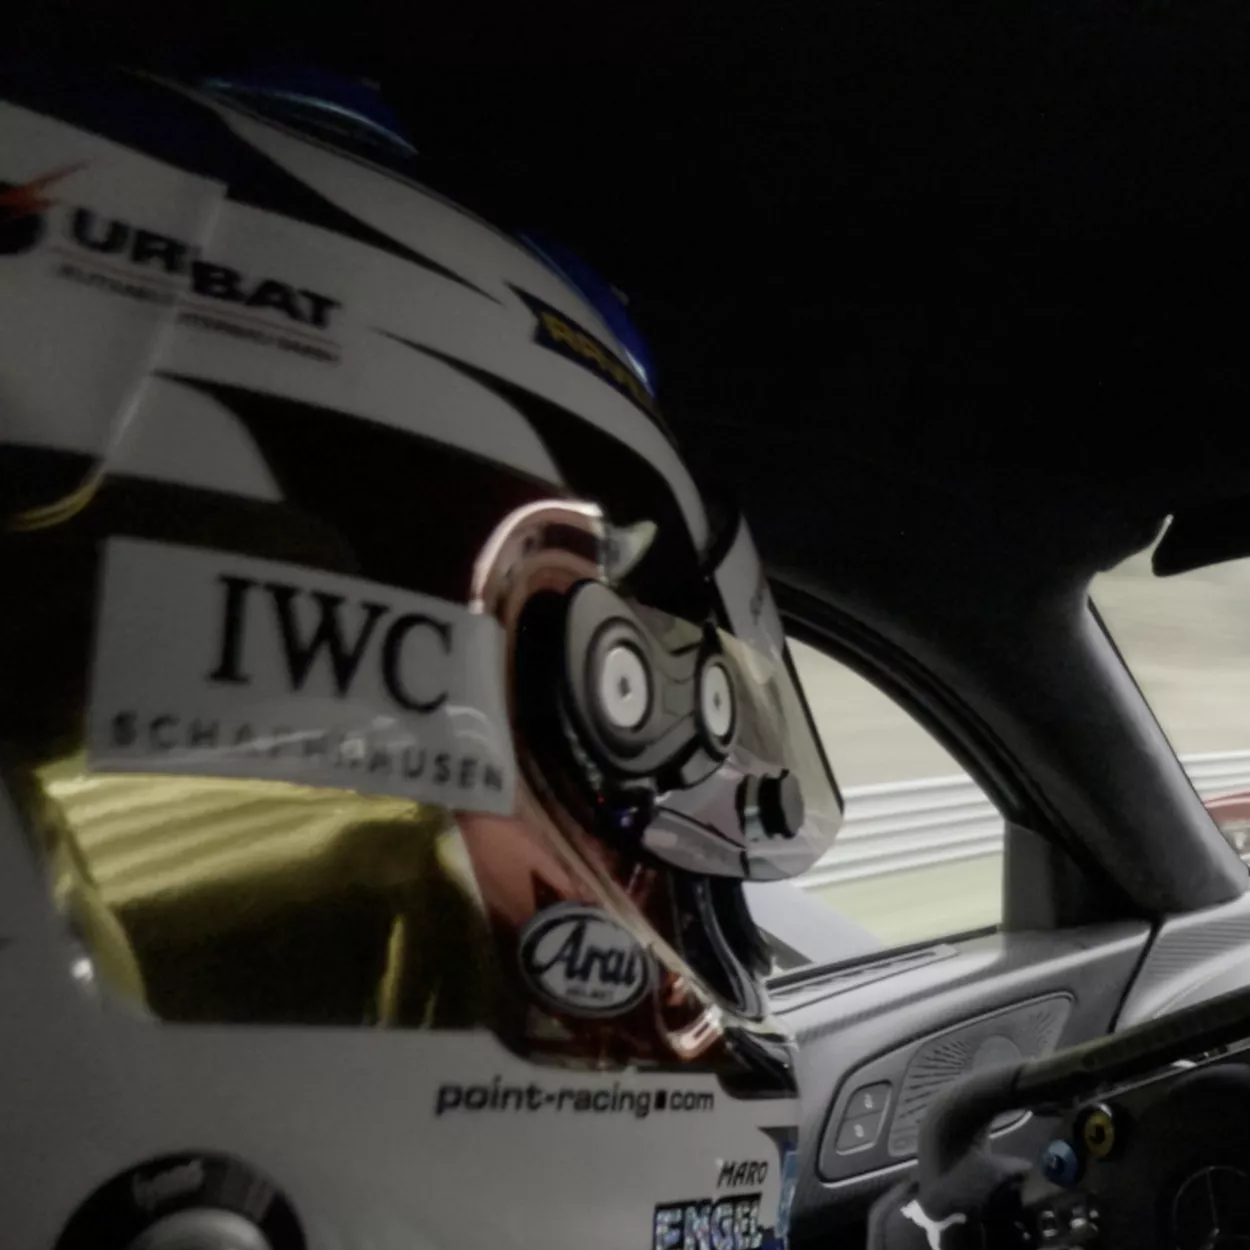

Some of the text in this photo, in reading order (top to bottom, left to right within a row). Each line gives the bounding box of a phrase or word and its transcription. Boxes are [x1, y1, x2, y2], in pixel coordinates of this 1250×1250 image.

[72, 207, 341, 328] URBAT
[207, 574, 455, 714] IWC
[110, 710, 504, 793] SCHAFAUSEN
[523, 913, 638, 987] Arai
[717, 1160, 769, 1189] MARO
